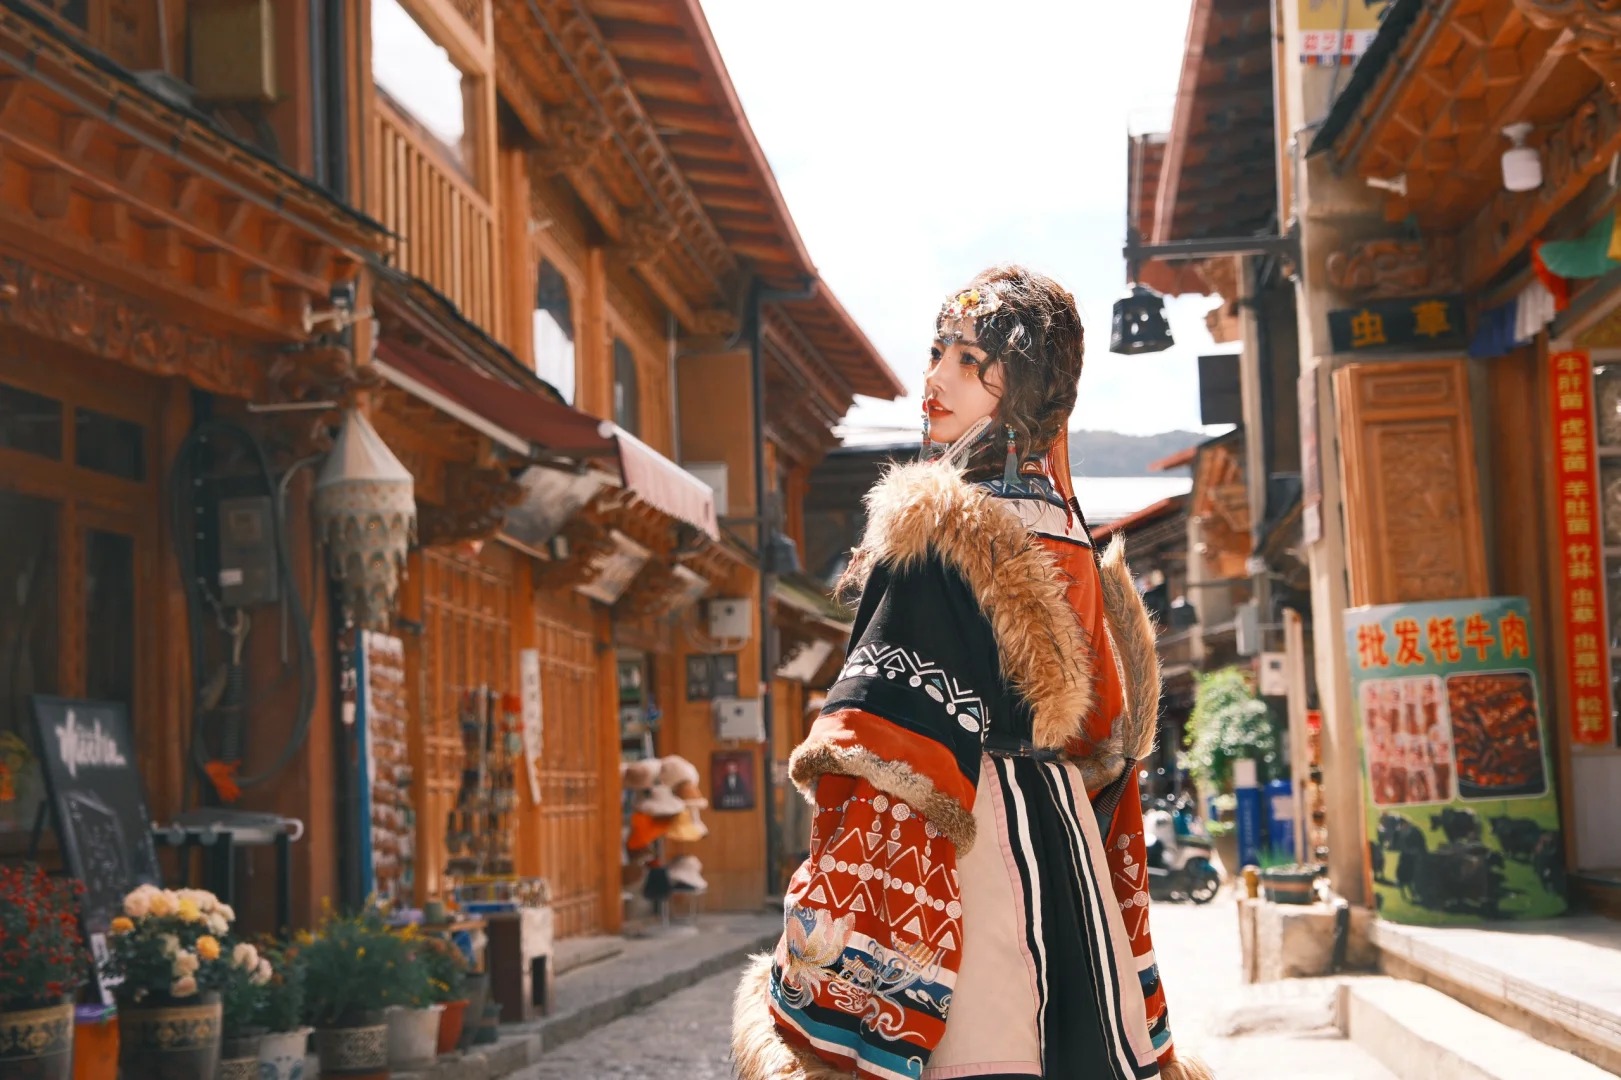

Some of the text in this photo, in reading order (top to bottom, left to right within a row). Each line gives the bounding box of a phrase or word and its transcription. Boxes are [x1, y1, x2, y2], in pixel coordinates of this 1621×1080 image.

[1356, 611, 1530, 668] 批发牦牛肉
